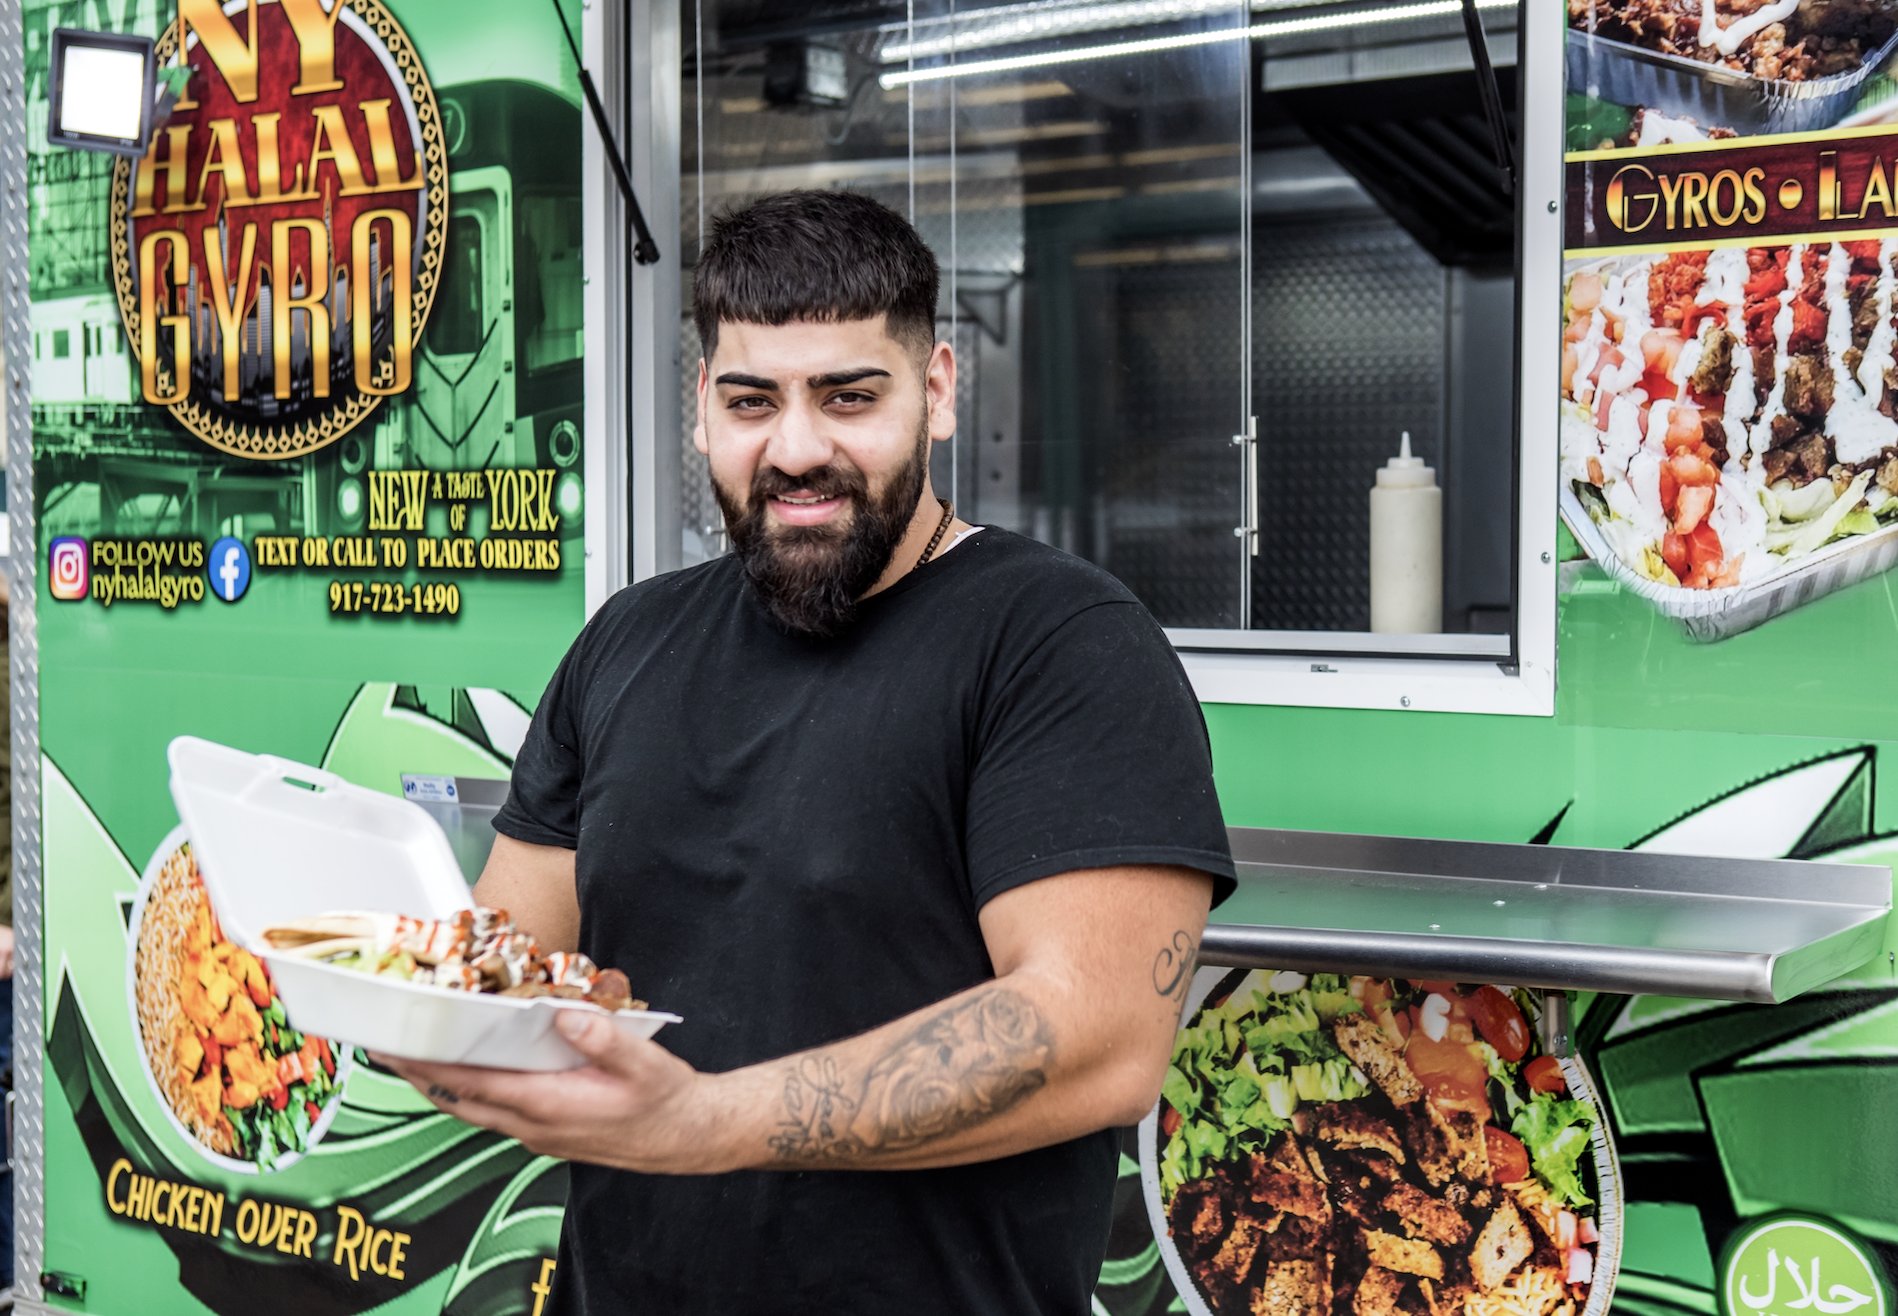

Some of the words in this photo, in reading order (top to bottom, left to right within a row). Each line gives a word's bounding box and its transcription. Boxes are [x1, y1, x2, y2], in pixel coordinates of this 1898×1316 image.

[172, 0, 347, 111] NY
[130, 98, 426, 217] HALAL
[1606, 163, 1766, 233] GYROS
[139, 208, 413, 405] GYRO
[368, 470, 430, 531] NEW
[484, 469, 560, 532] YORK
[432, 472, 443, 499] A
[446, 472, 485, 499] TASTE
[450, 503, 467, 531] OF
[92, 540, 176, 567] FOLLOW
[178, 540, 204, 567] US
[254, 536, 299, 566] TEXT
[302, 537, 329, 566] OR
[332, 537, 378, 567] CALL
[380, 537, 407, 568] TO
[417, 538, 477, 568] PLACE
[479, 538, 561, 570] ORDERS
[92, 563, 205, 608] nyhalalgyro
[329, 581, 460, 614] 917-723-1490
[106, 1157, 225, 1238] CHICKEN
[333, 1205, 413, 1282] RICE
[1739, 1247, 1874, 1315] حلال
